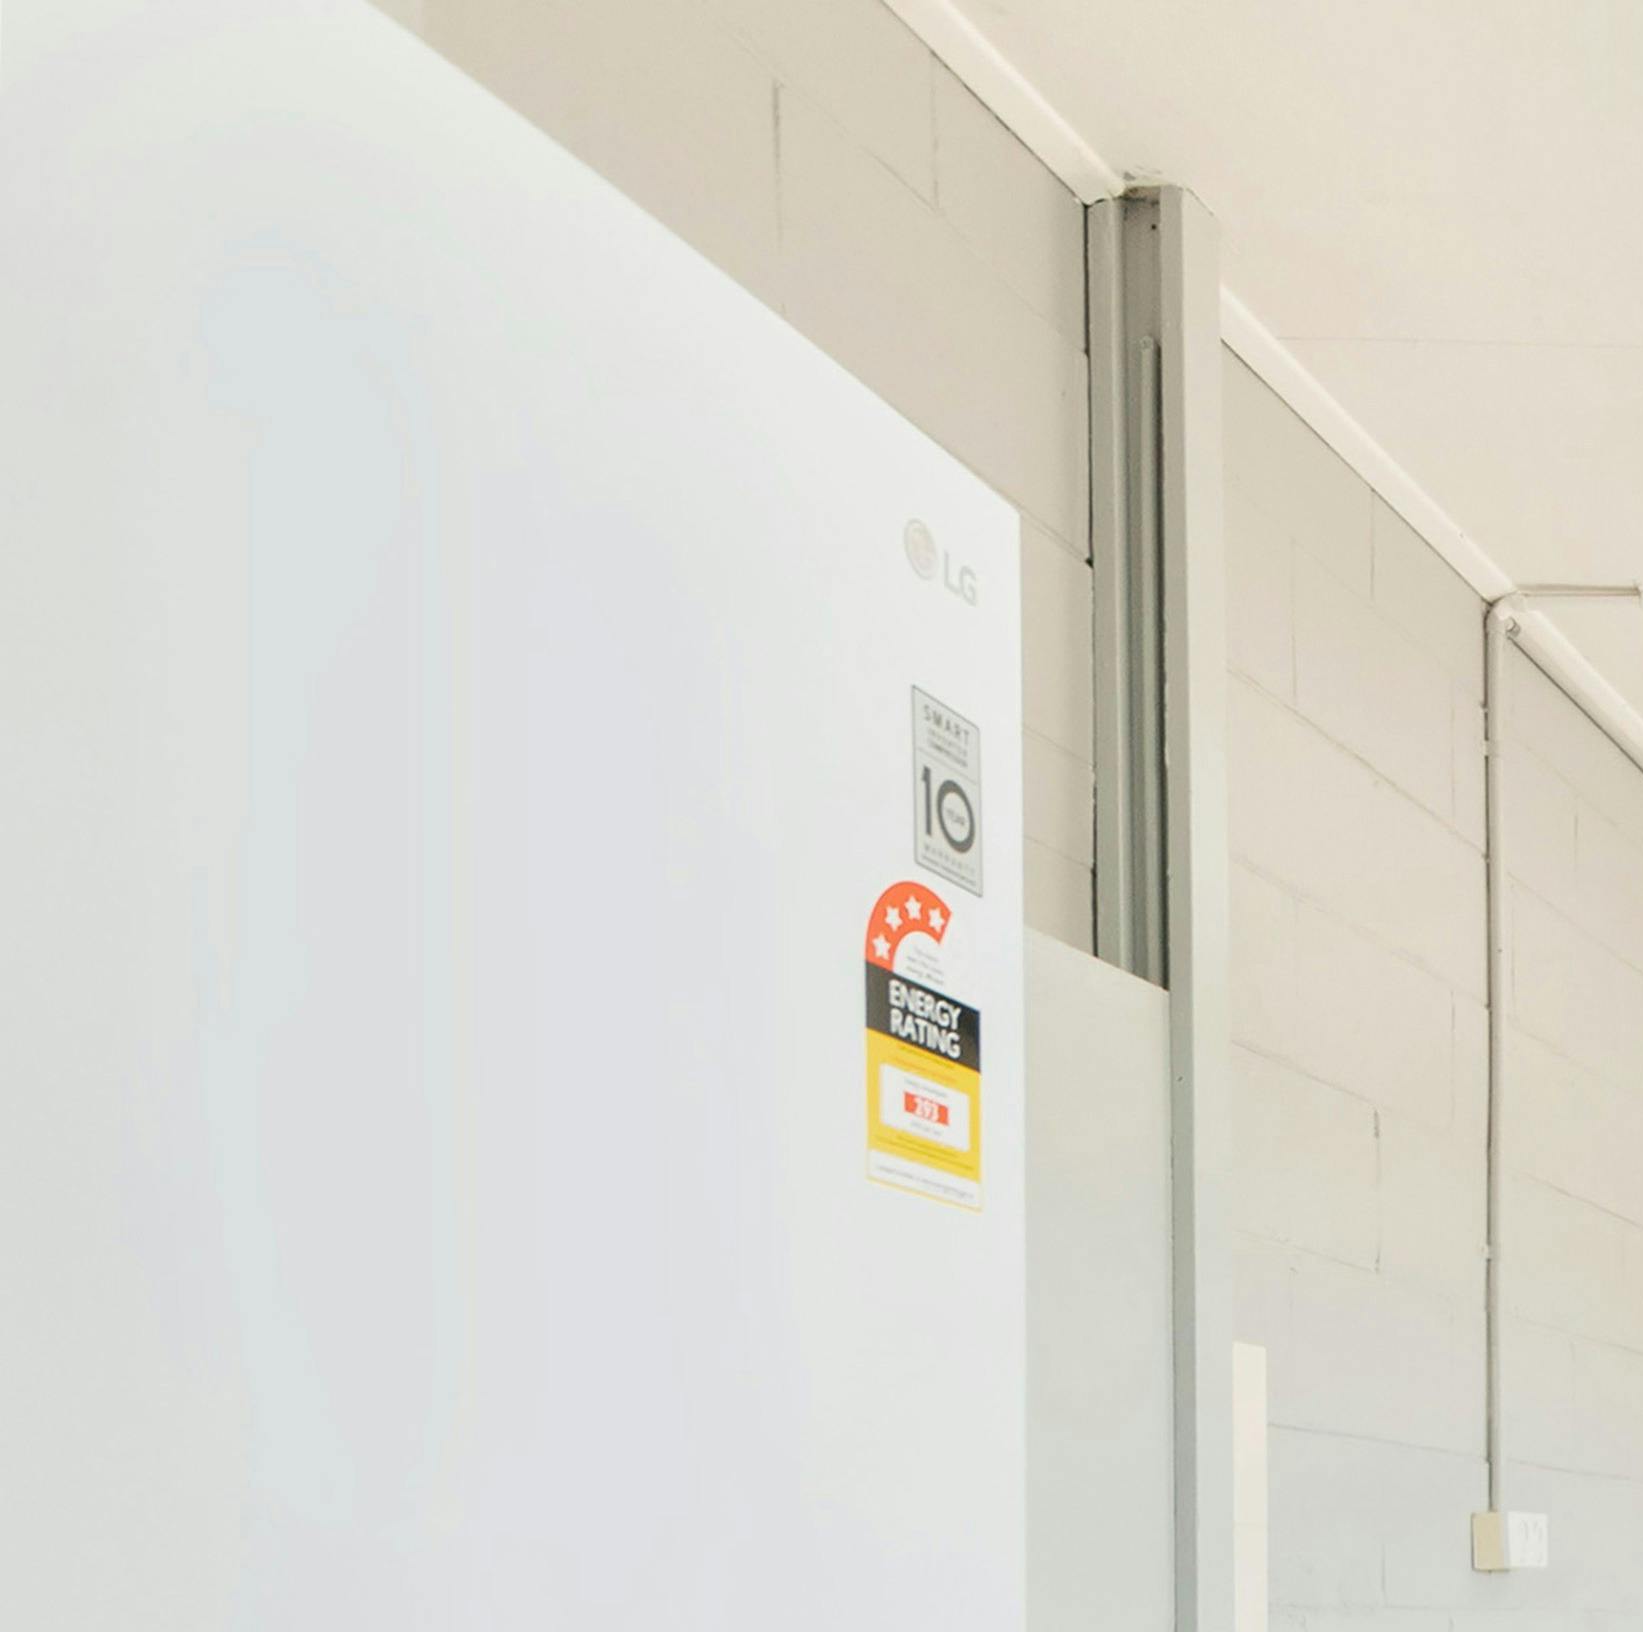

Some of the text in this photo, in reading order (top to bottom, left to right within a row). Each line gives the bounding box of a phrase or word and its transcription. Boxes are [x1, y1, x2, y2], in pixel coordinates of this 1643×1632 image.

[943, 549, 977, 606] LG
[924, 703, 970, 746] SMART
[921, 764, 975, 853] 10
[888, 979, 962, 1030] ENERGY
[890, 1007, 961, 1059] RATING
